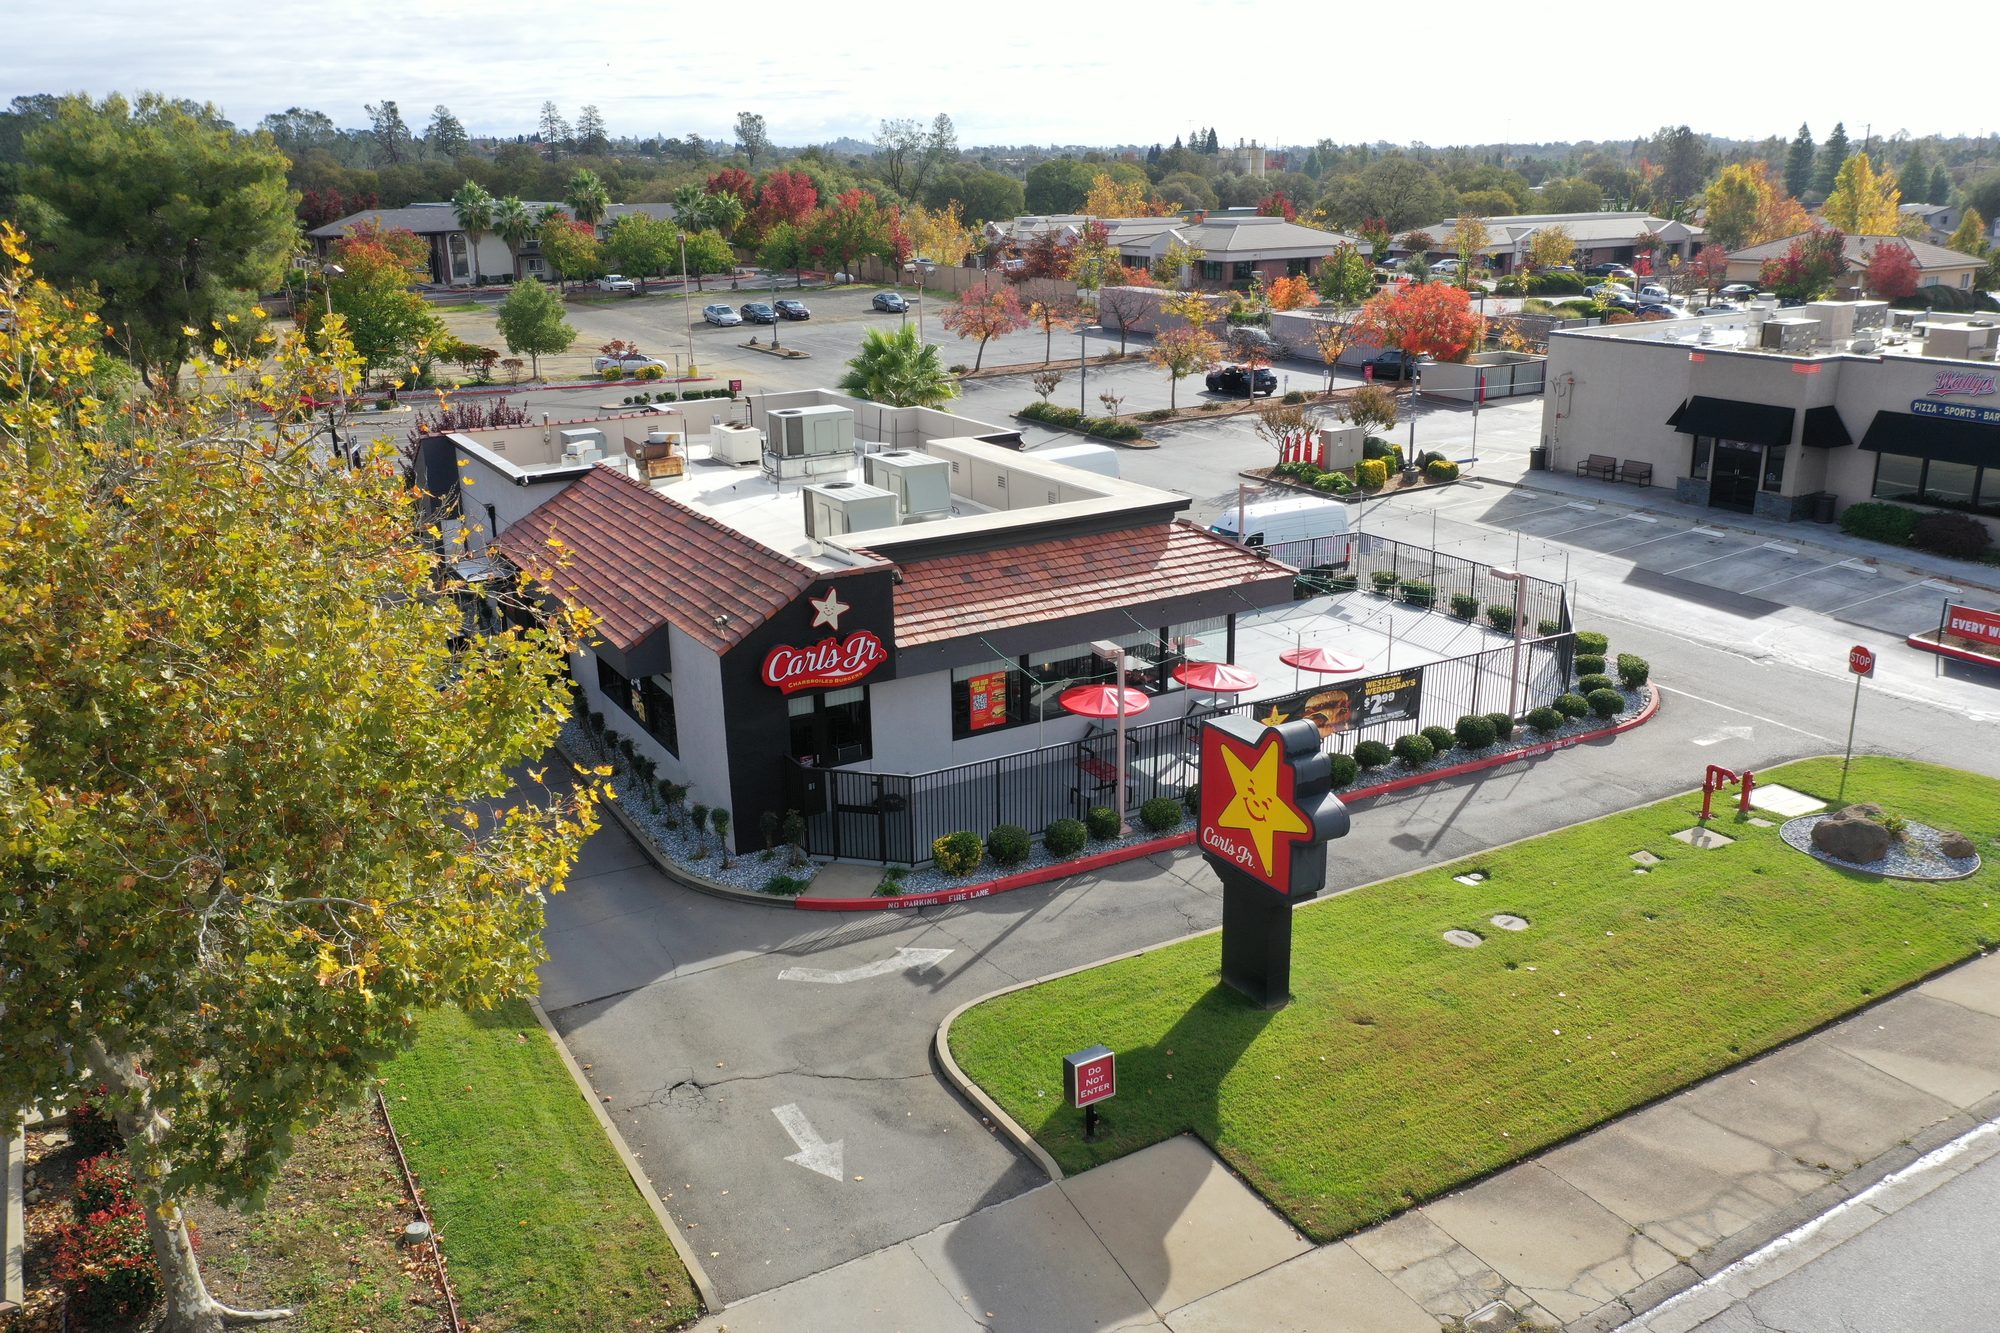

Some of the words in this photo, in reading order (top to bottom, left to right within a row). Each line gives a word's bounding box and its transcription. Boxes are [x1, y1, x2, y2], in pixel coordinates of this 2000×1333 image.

[1913, 402, 1937, 414] PIZZA
[1943, 406, 1976, 419] SPORTS
[1951, 618, 1986, 634] EVERY
[768, 641, 842, 682] Carl's
[1850, 651, 1871, 667] STOP
[1365, 676, 1402, 689] WESTERN
[1203, 826, 1236, 856] Carl's
[1235, 845, 1256, 869] Jr.
[903, 898, 938, 908] PARKING
[948, 893, 967, 903] FIRE
[970, 888, 990, 899] LANE
[1087, 1066, 1102, 1076] DO
[1085, 1074, 1105, 1087] NOT
[1080, 1082, 1110, 1099] ENTER
